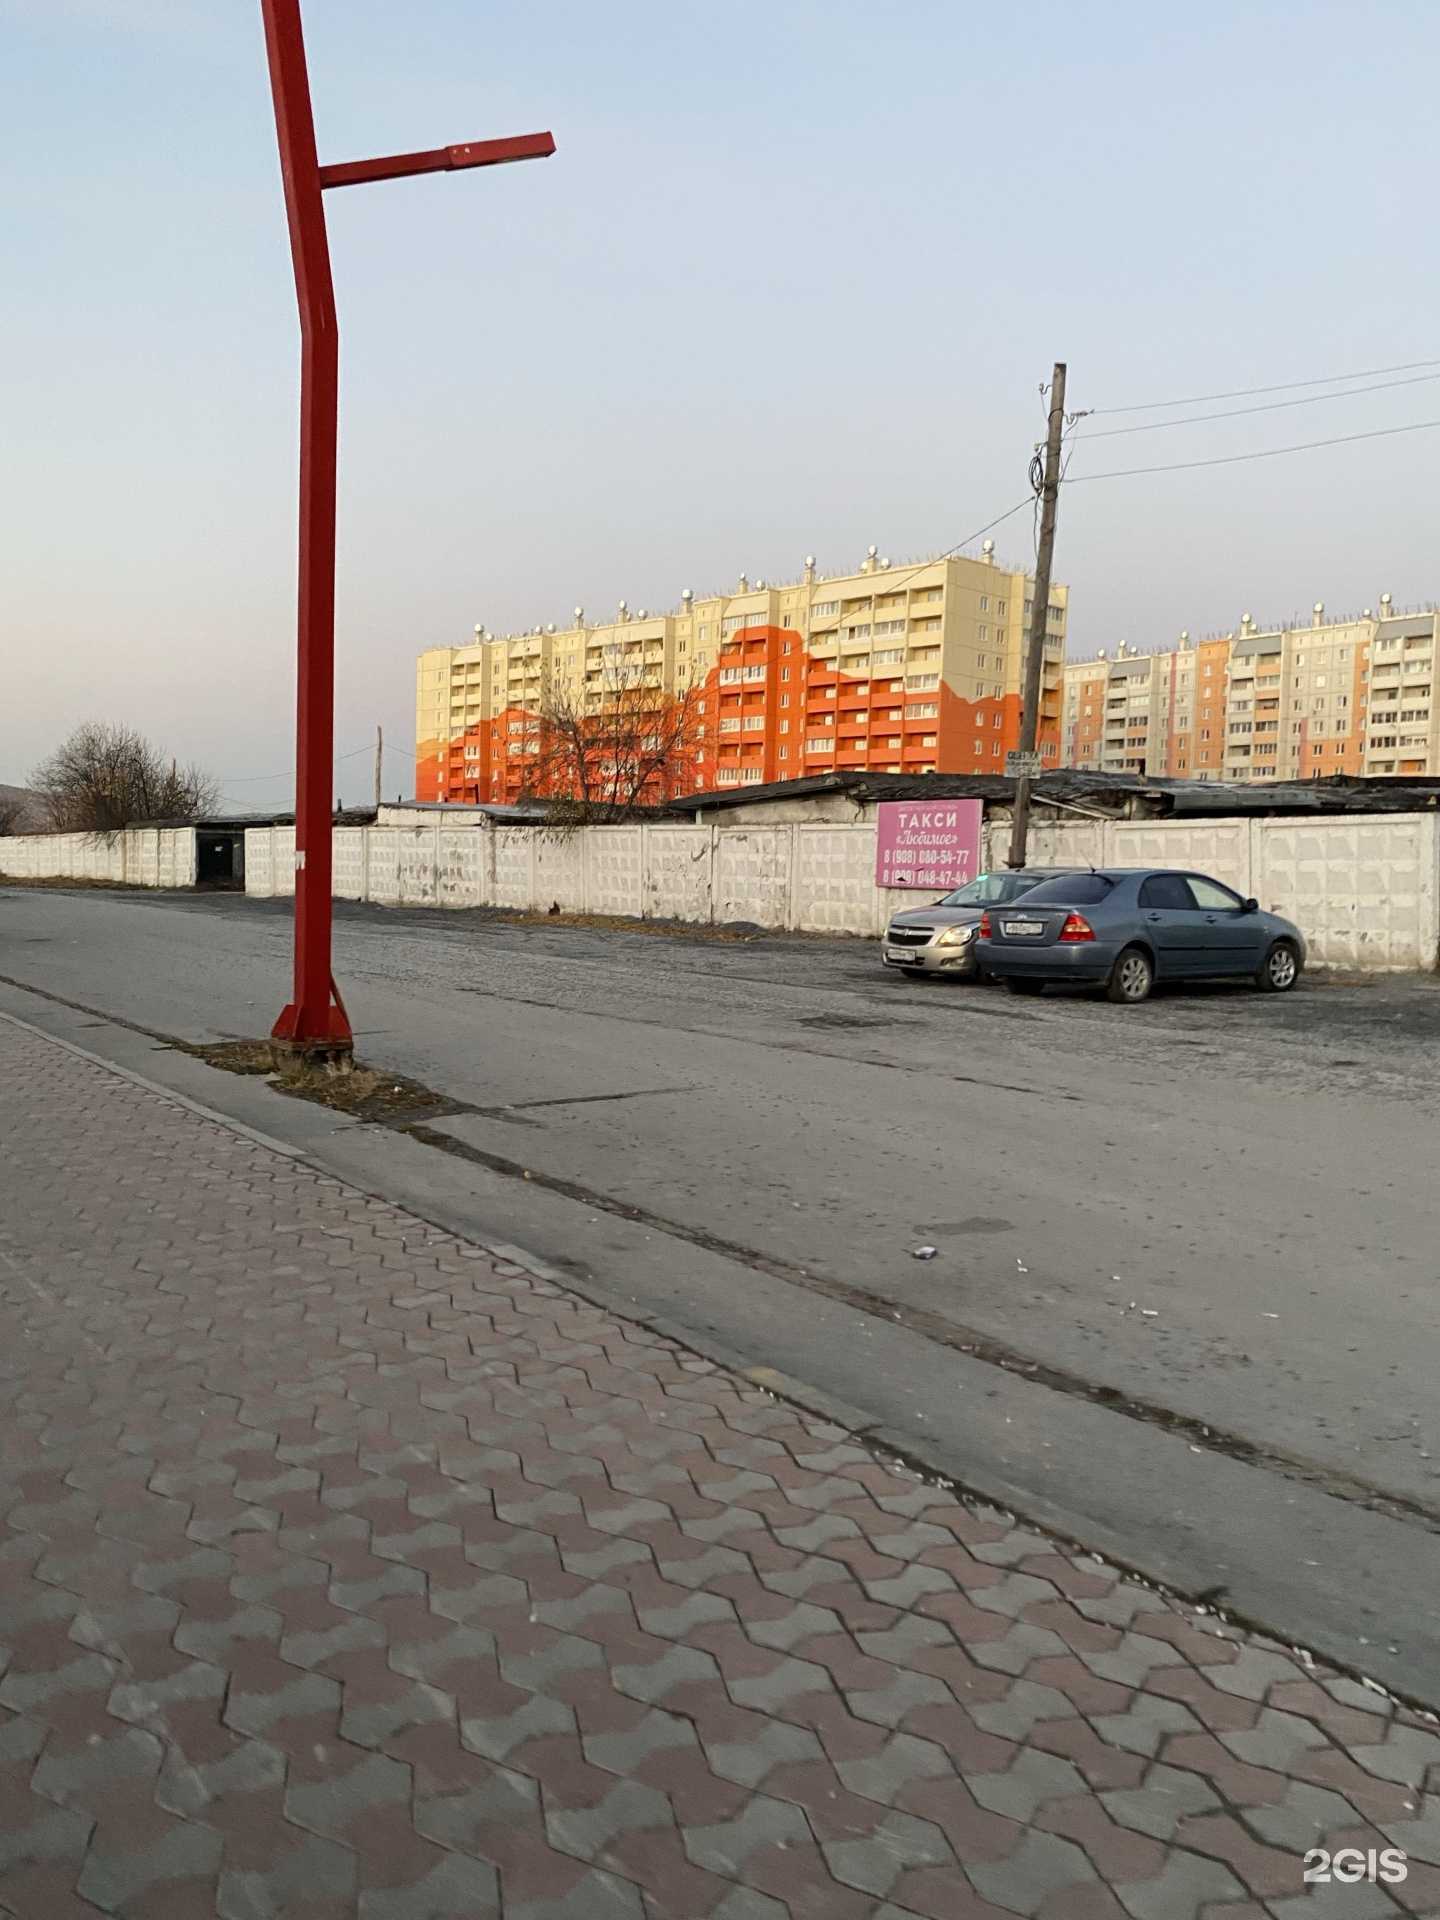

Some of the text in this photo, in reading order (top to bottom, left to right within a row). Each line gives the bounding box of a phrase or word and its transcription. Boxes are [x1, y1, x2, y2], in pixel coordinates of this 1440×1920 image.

[898, 812, 957, 828] ТАКСИ
[883, 849, 890, 864] 8
[882, 869, 889, 883] 8
